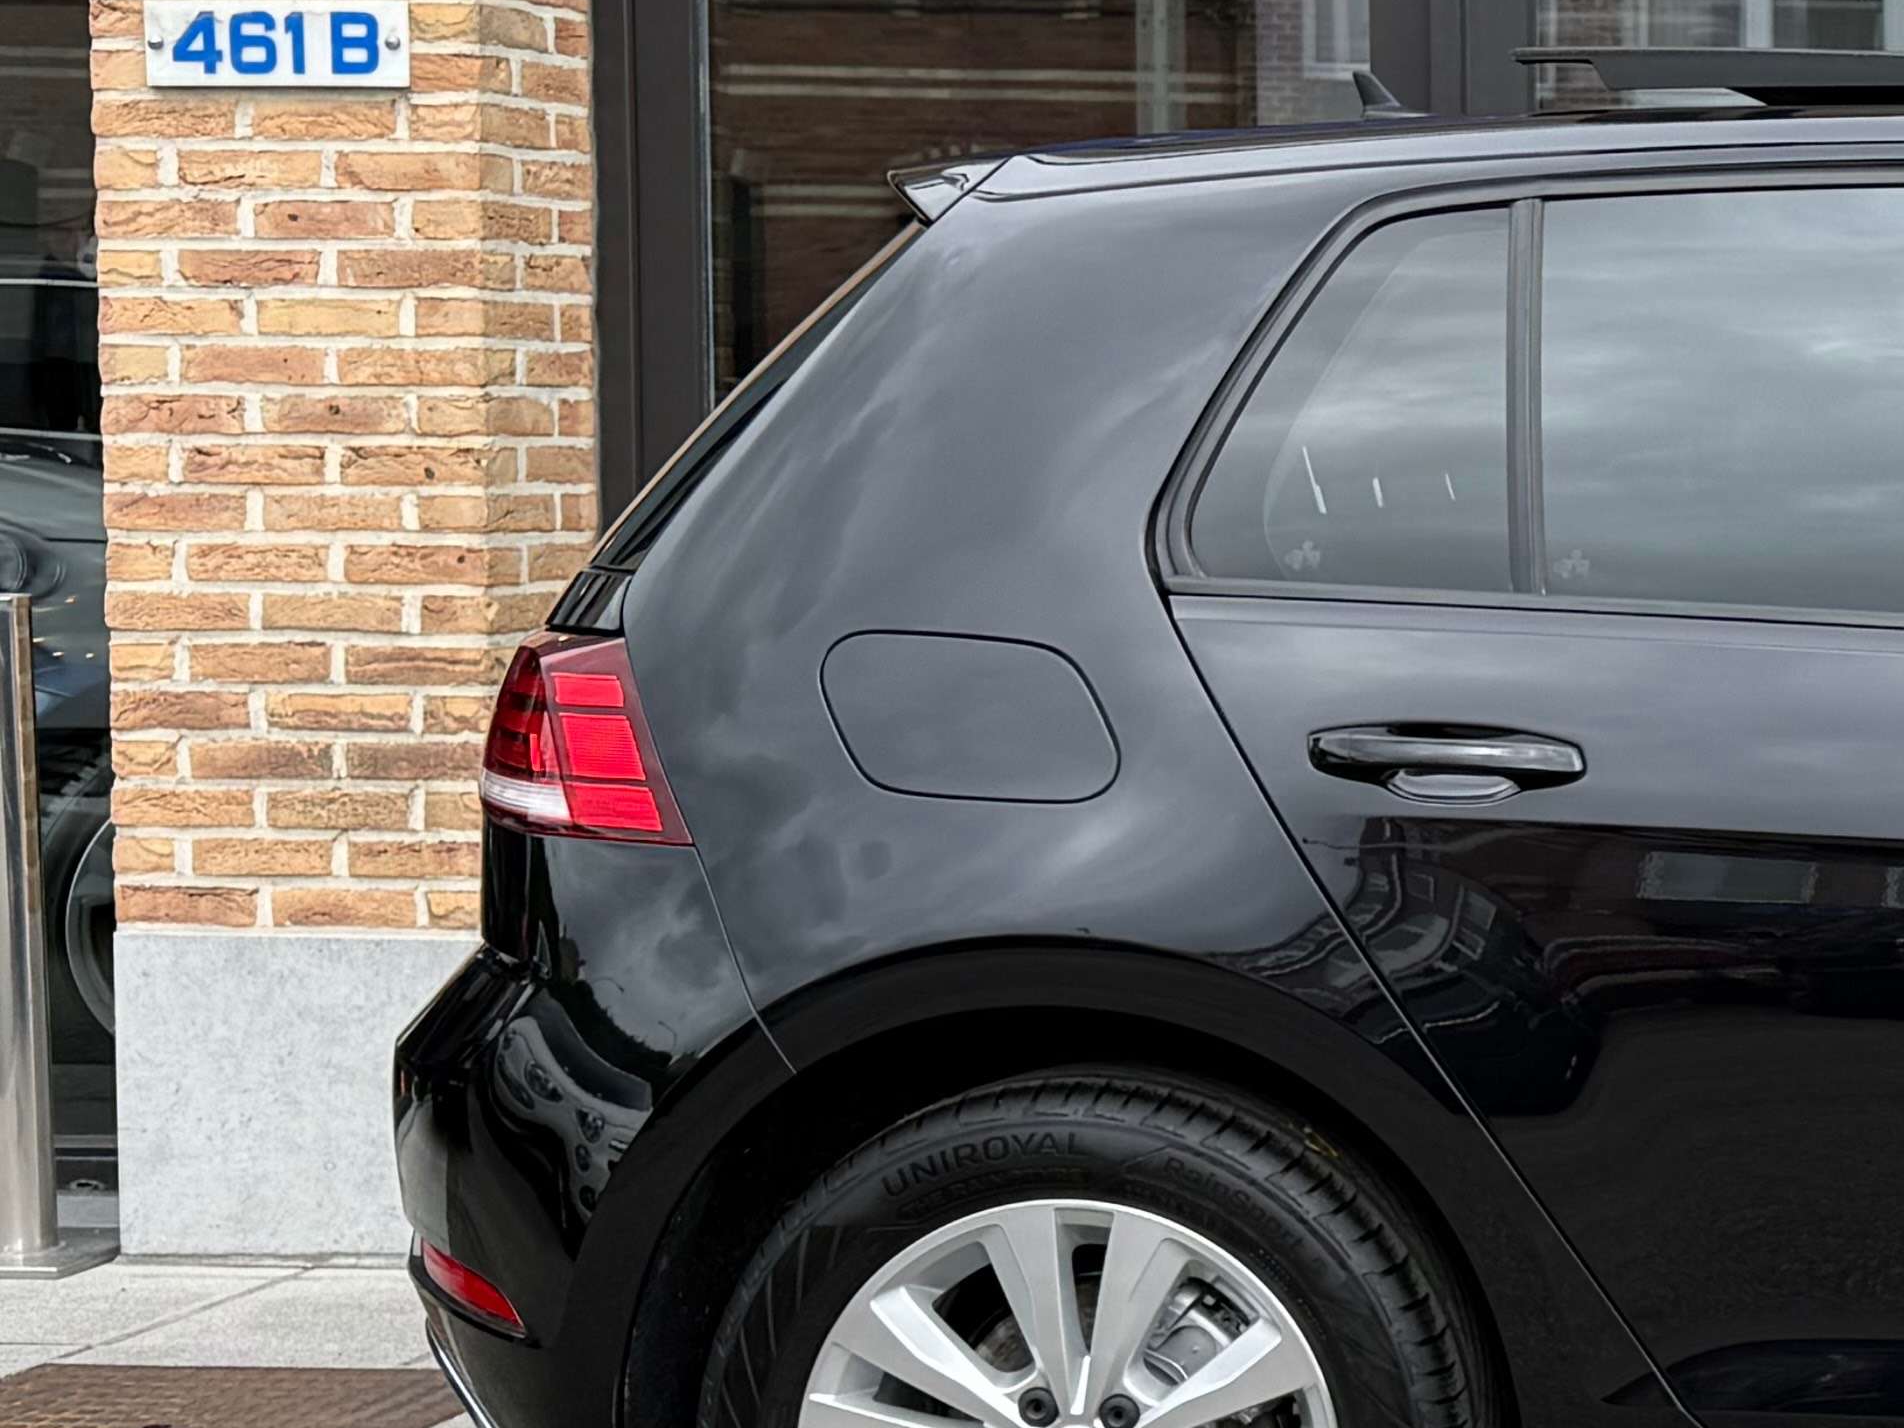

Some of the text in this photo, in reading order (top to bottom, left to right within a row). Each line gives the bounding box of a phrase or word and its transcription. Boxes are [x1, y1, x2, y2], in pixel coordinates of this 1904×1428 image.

[174, 12, 379, 75] 461 B
[882, 1129, 1089, 1198] UNIROYAL
